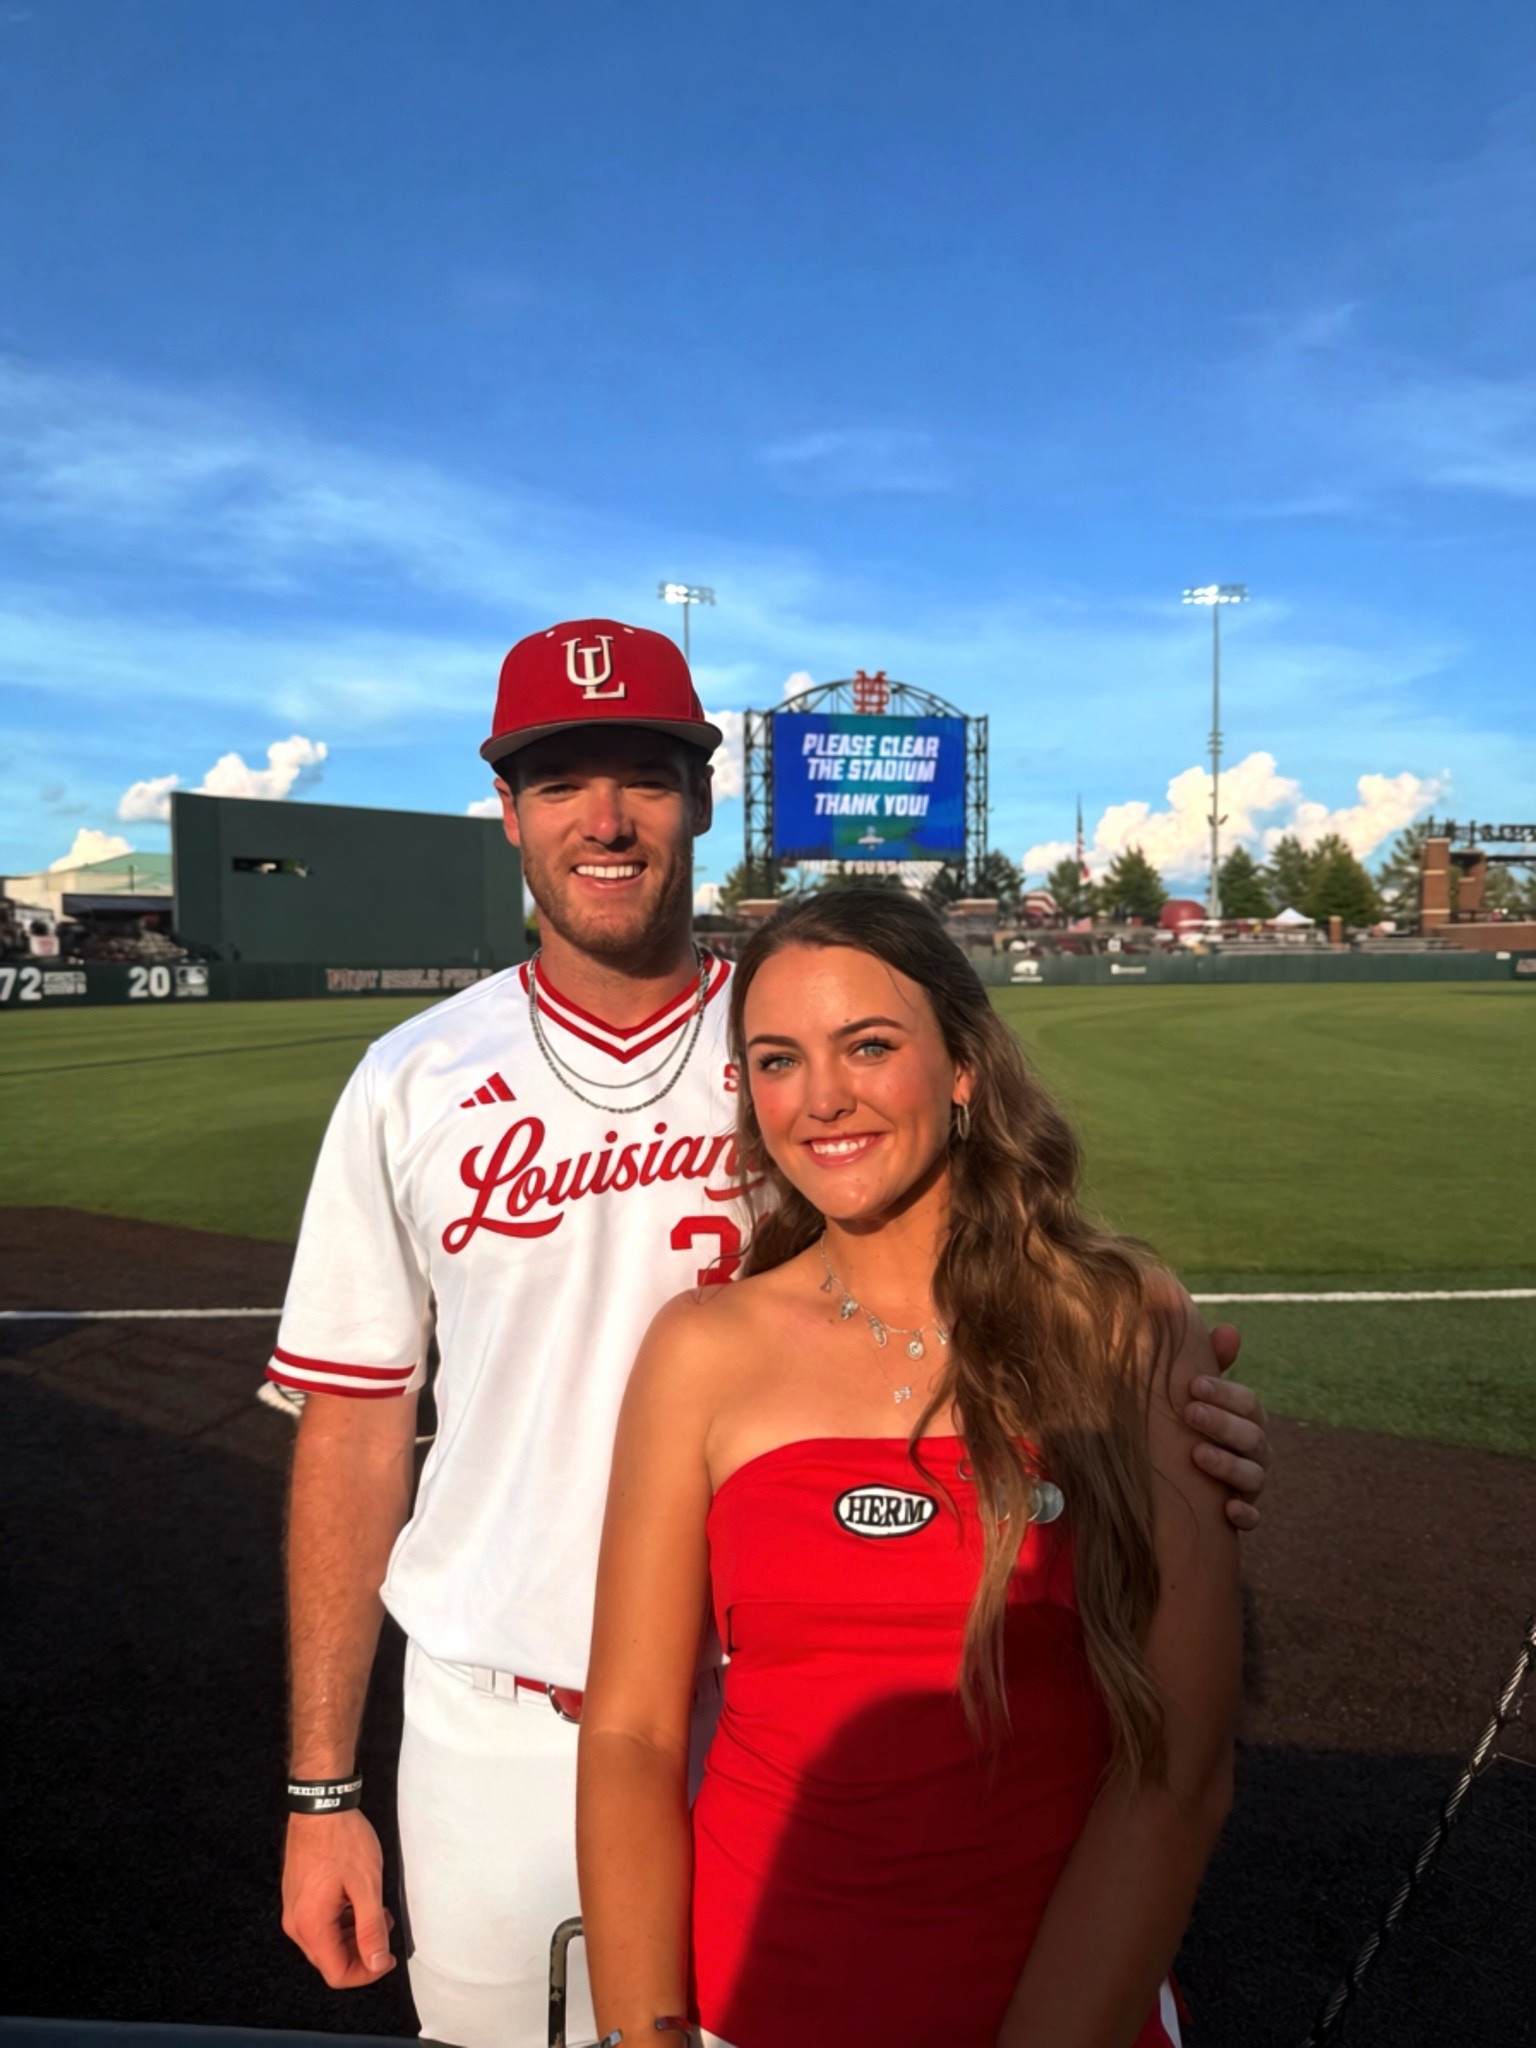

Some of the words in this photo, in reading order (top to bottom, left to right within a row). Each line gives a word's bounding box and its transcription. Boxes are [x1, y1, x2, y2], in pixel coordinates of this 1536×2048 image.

[802, 733, 876, 756] PLEASE
[879, 736, 940, 758] CLEAR
[808, 758, 845, 781] THE
[847, 760, 936, 782] STADIUM
[814, 793, 879, 815] THANK
[883, 794, 930, 816] YOU!
[128, 965, 171, 998] 20
[441, 1116, 765, 1254] Louisian
[845, 1494, 929, 1527] HERM
